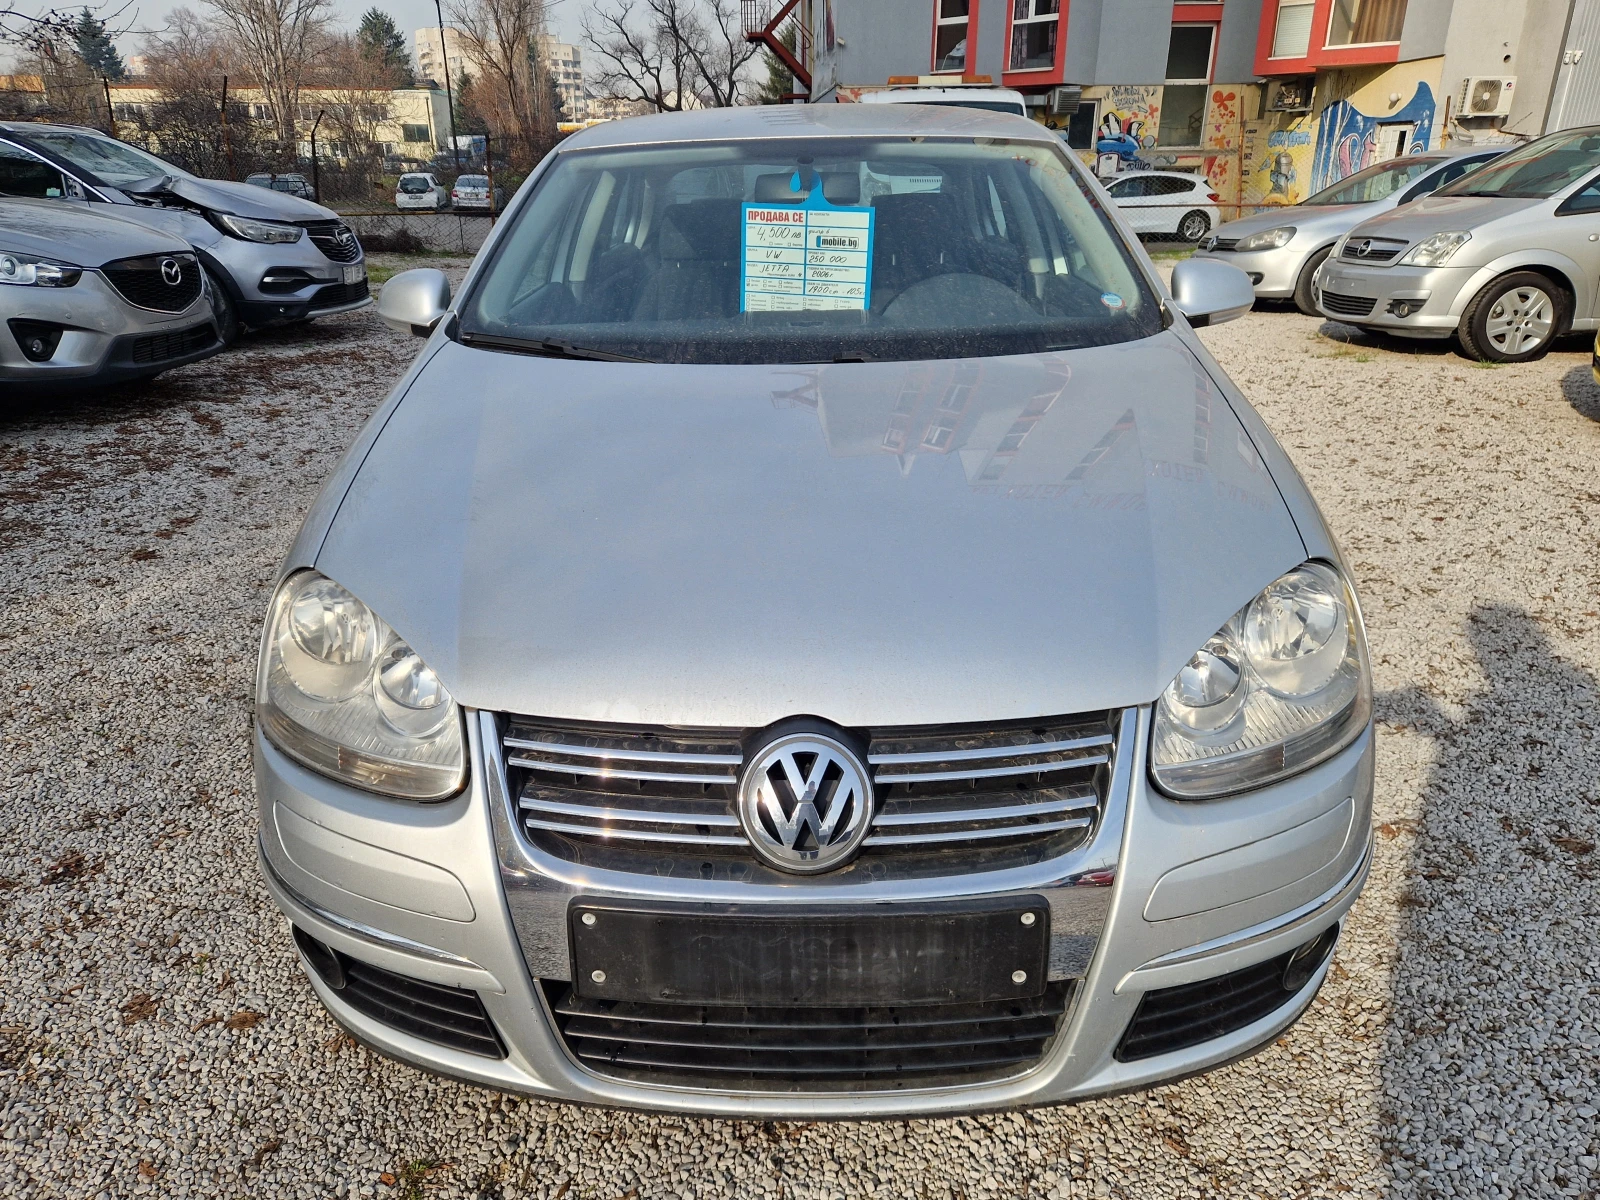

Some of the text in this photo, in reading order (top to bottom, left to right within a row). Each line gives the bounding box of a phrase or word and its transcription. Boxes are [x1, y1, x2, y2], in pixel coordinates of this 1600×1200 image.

[748, 211, 804, 223] ПРОДАВА СЕ
[821, 237, 858, 248] mobile.bg
[808, 255, 825, 264] 250
[759, 264, 790, 273] JETTA
